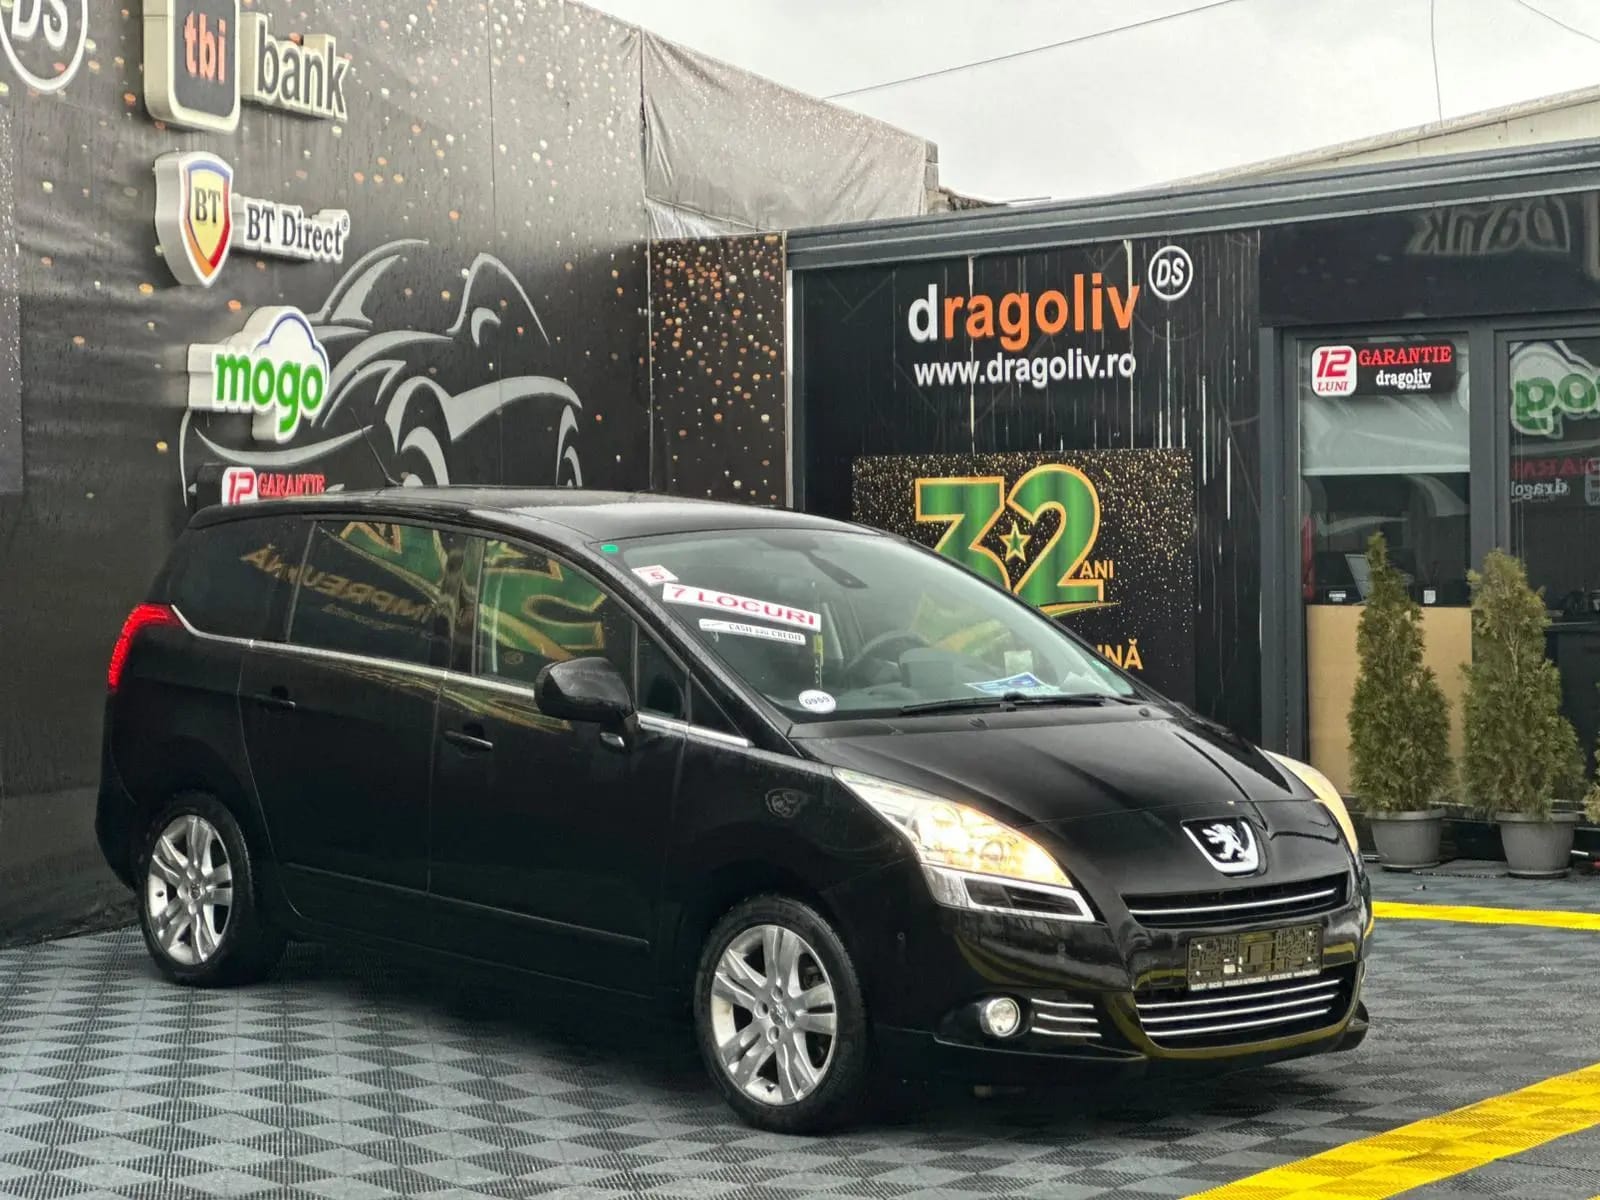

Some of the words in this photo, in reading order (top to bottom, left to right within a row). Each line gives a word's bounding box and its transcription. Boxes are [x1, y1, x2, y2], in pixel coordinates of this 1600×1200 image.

[184, 11, 226, 82] tbi
[256, 17, 347, 119] bank
[194, 187, 221, 224] BT
[246, 203, 276, 244] BT
[1156, 257, 1185, 288] DS
[907, 271, 1141, 352] dragoliv
[913, 347, 1137, 389] www.dragoliv.ro
[1316, 349, 1352, 378] 12
[1358, 346, 1452, 367] GARANTIE
[215, 353, 324, 433] mogo
[1317, 381, 1348, 393] LUNI
[1376, 368, 1432, 390] dragoliv
[257, 472, 325, 497] GARANTIE
[1079, 560, 1115, 580] ANI
[671, 586, 687, 599] 7
[697, 591, 815, 625] LOCURI
[728, 623, 752, 634] CASH
[770, 629, 802, 642] CREDIT
